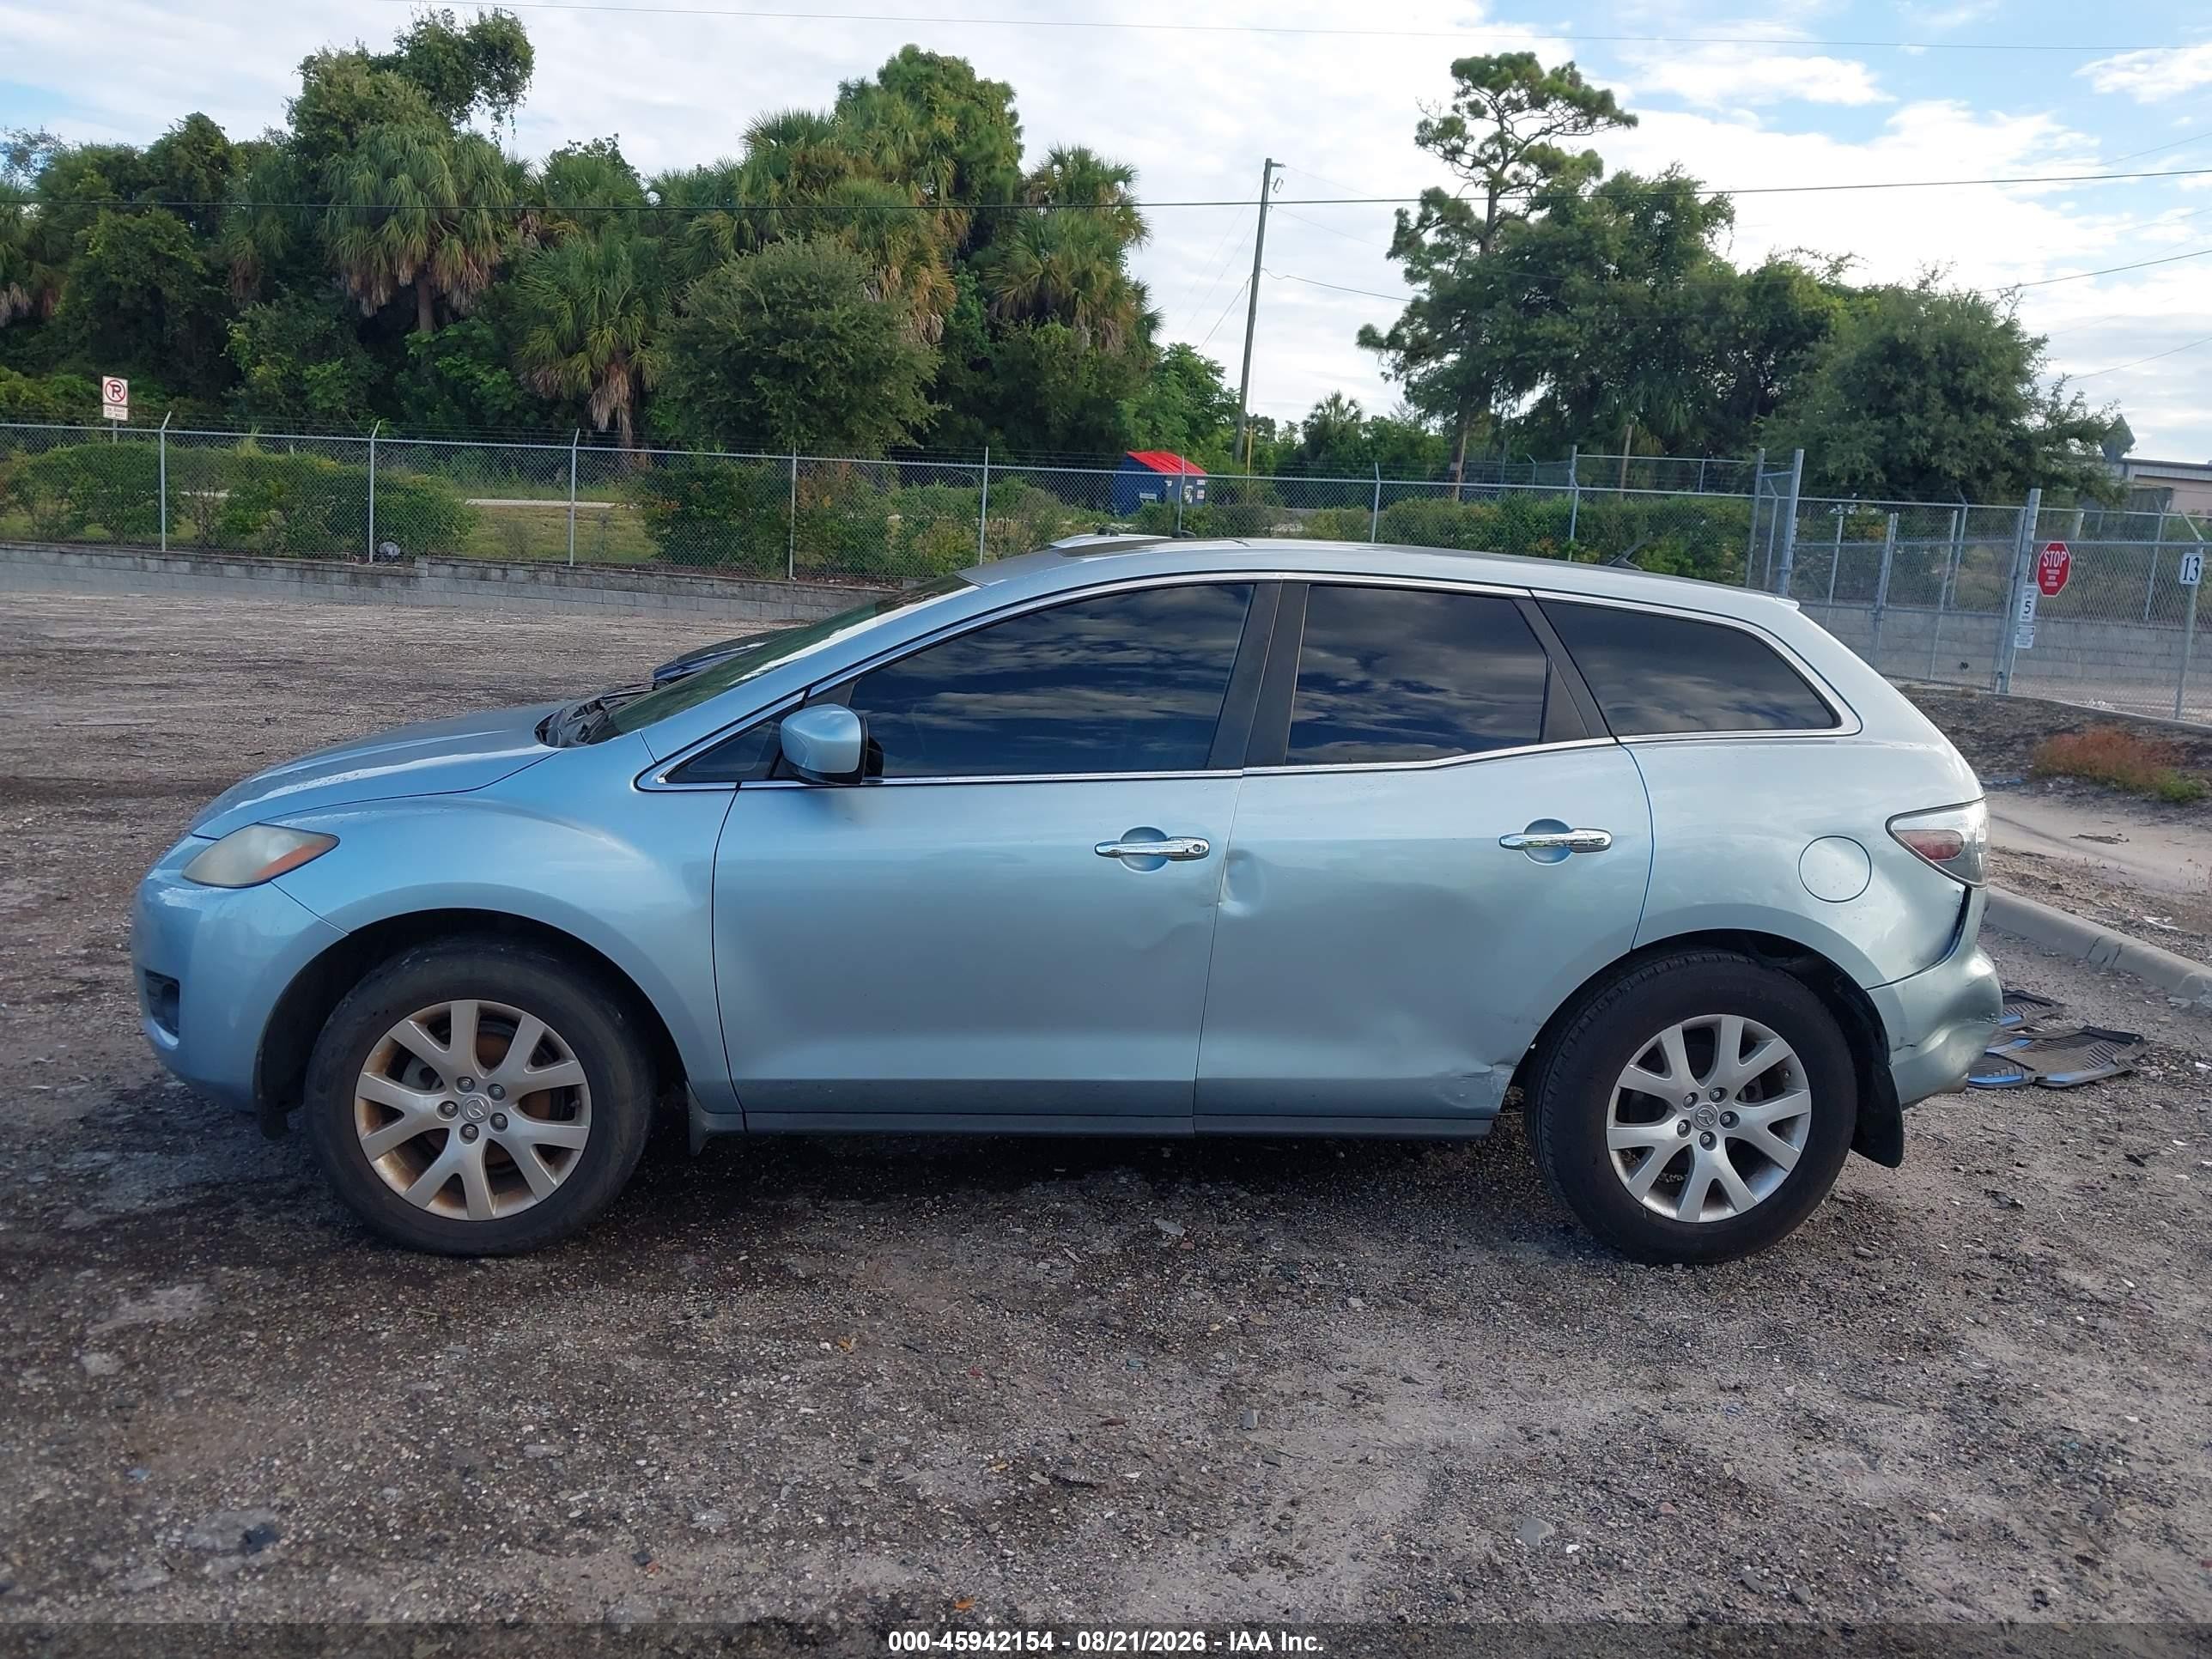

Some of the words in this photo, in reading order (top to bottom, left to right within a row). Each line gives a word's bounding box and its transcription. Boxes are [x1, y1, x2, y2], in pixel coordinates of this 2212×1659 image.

[2043, 550, 2067, 568] STOP
[2183, 556, 2200, 581] 13
[2023, 600, 2032, 614] 5
